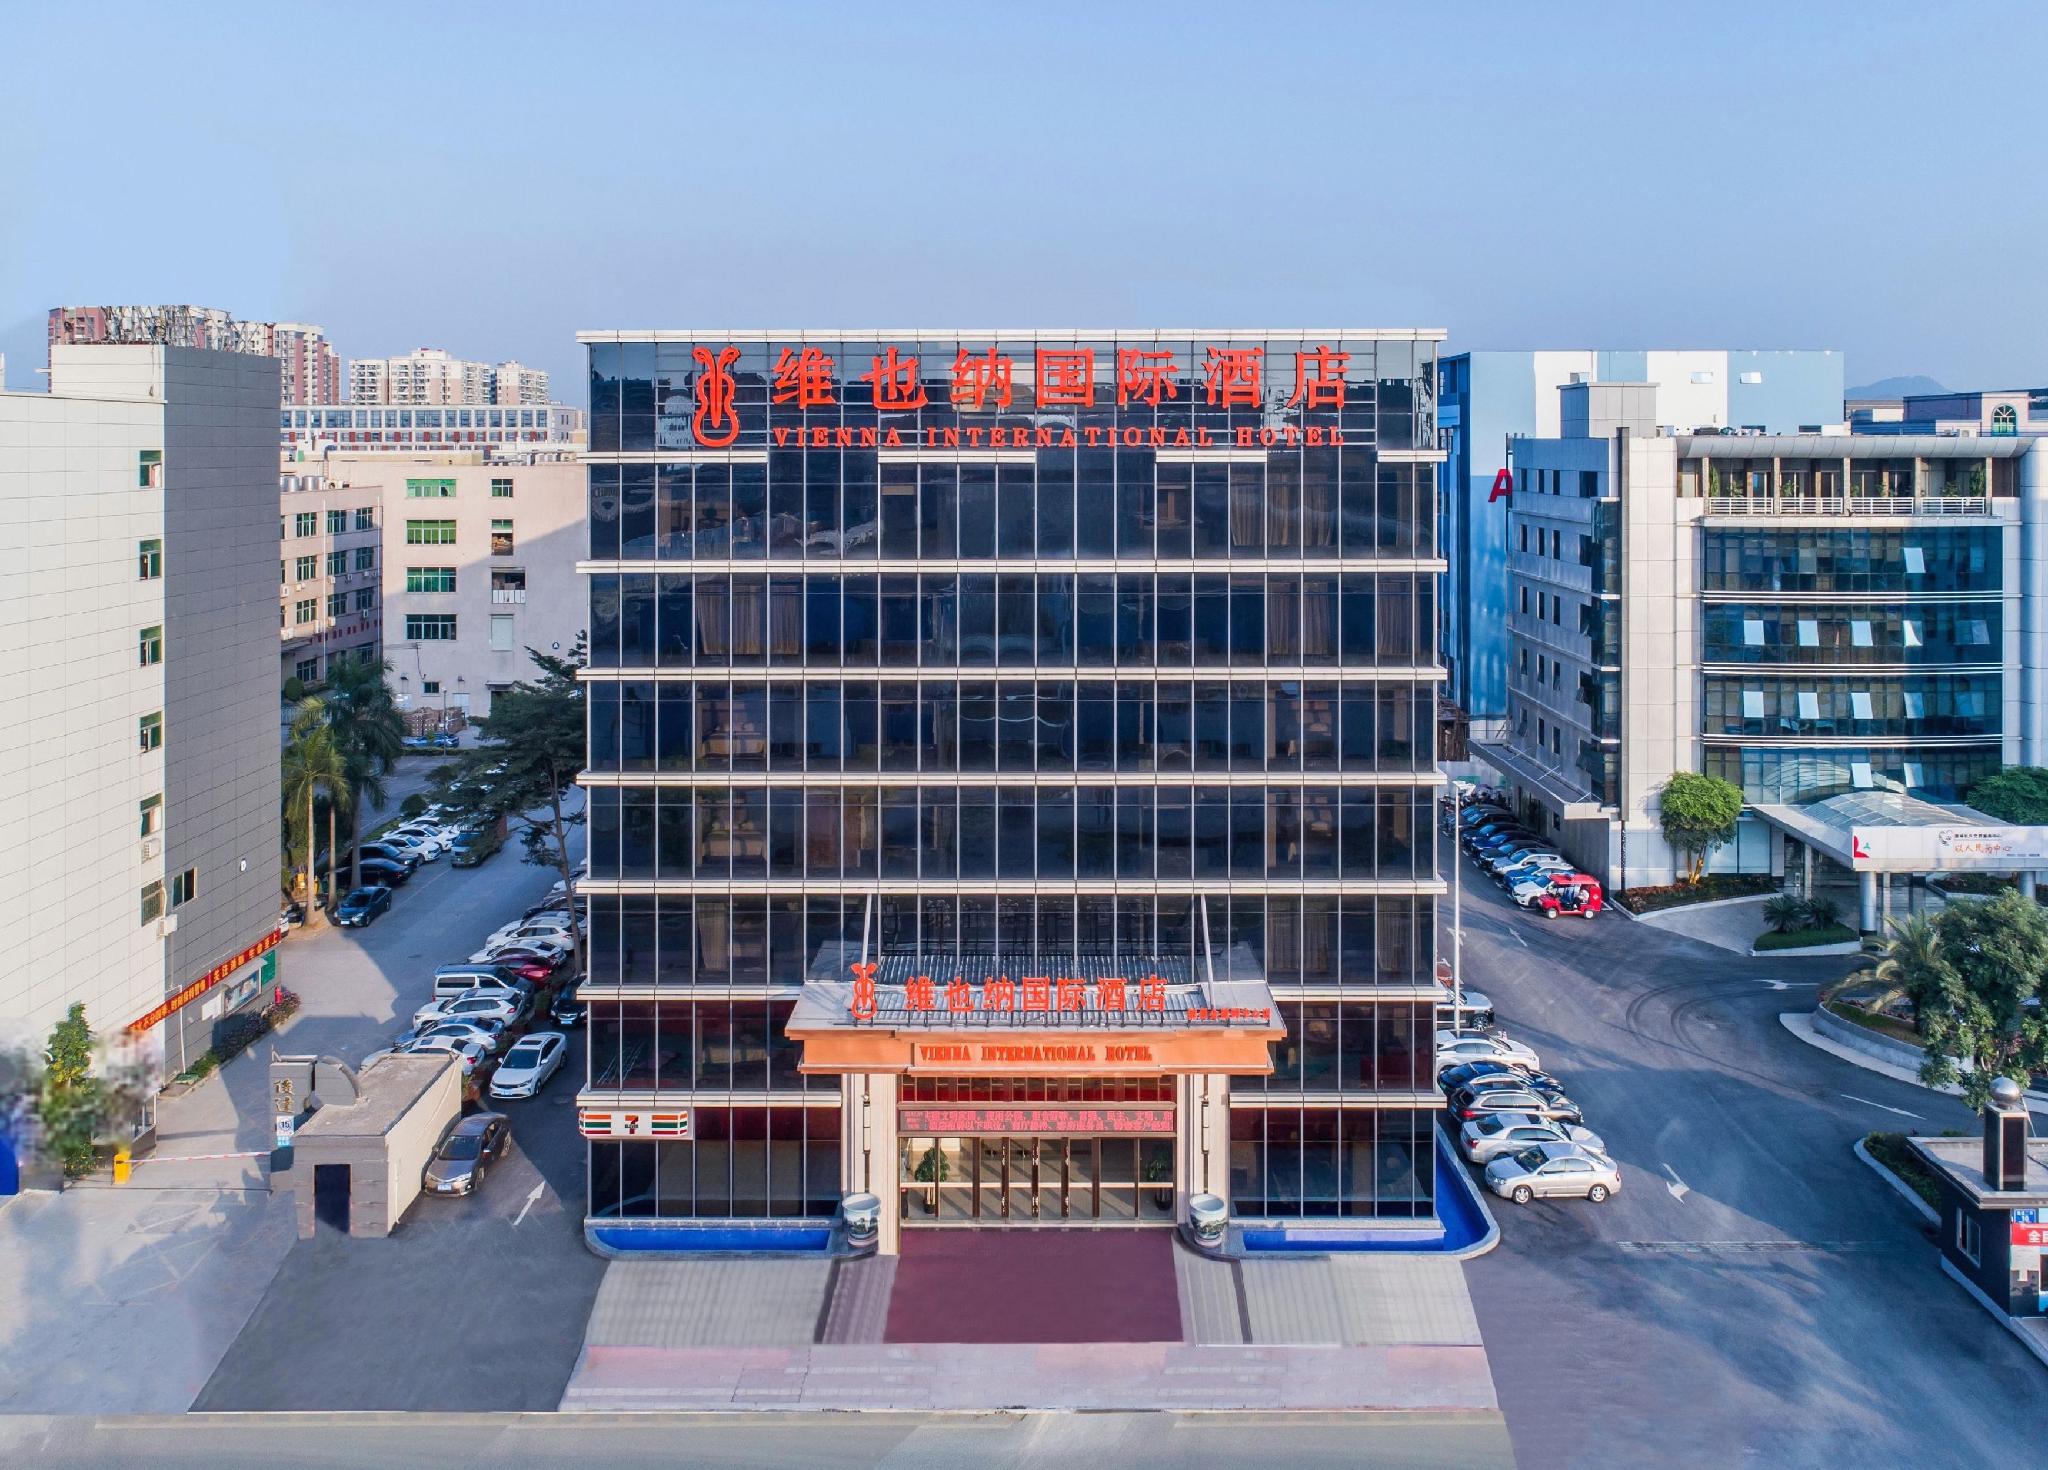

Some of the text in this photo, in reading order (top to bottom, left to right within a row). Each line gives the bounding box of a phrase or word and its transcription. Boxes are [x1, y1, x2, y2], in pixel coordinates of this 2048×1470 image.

[773, 345, 1351, 410] 维也纳国际酒店
[773, 427, 1345, 448] VIENNA INTERNATIONAL HOTEL
[904, 975, 1168, 1013] 维也纳国际酒店
[919, 1045, 1154, 1062] VIENNA INTERNATIONAL HOTEL
